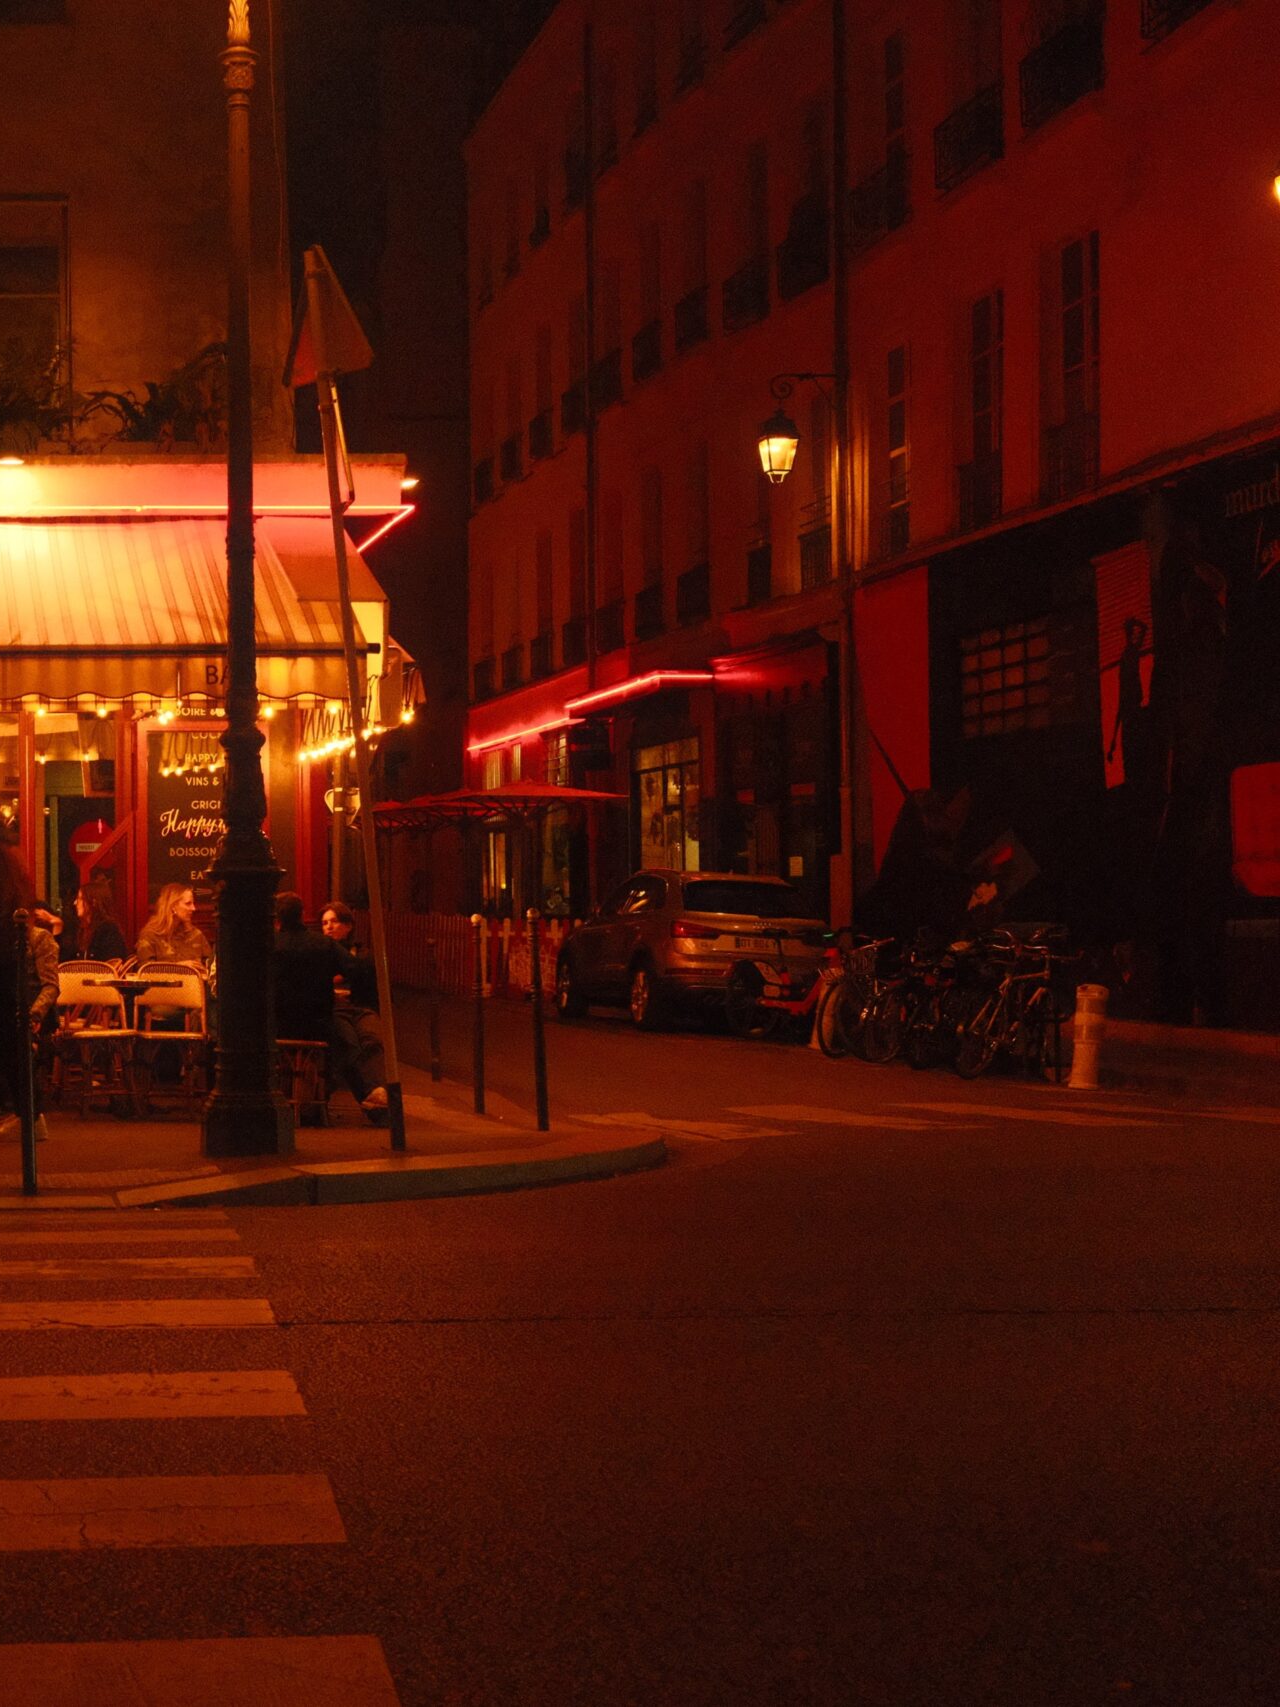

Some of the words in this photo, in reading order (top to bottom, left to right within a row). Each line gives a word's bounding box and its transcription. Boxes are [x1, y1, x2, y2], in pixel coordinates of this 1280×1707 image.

[184, 752, 218, 763] HAPPY
[185, 777, 209, 787] VINS
[213, 777, 220, 787] &
[160, 808, 217, 837] Happy
[169, 846, 217, 857] BOISSON
